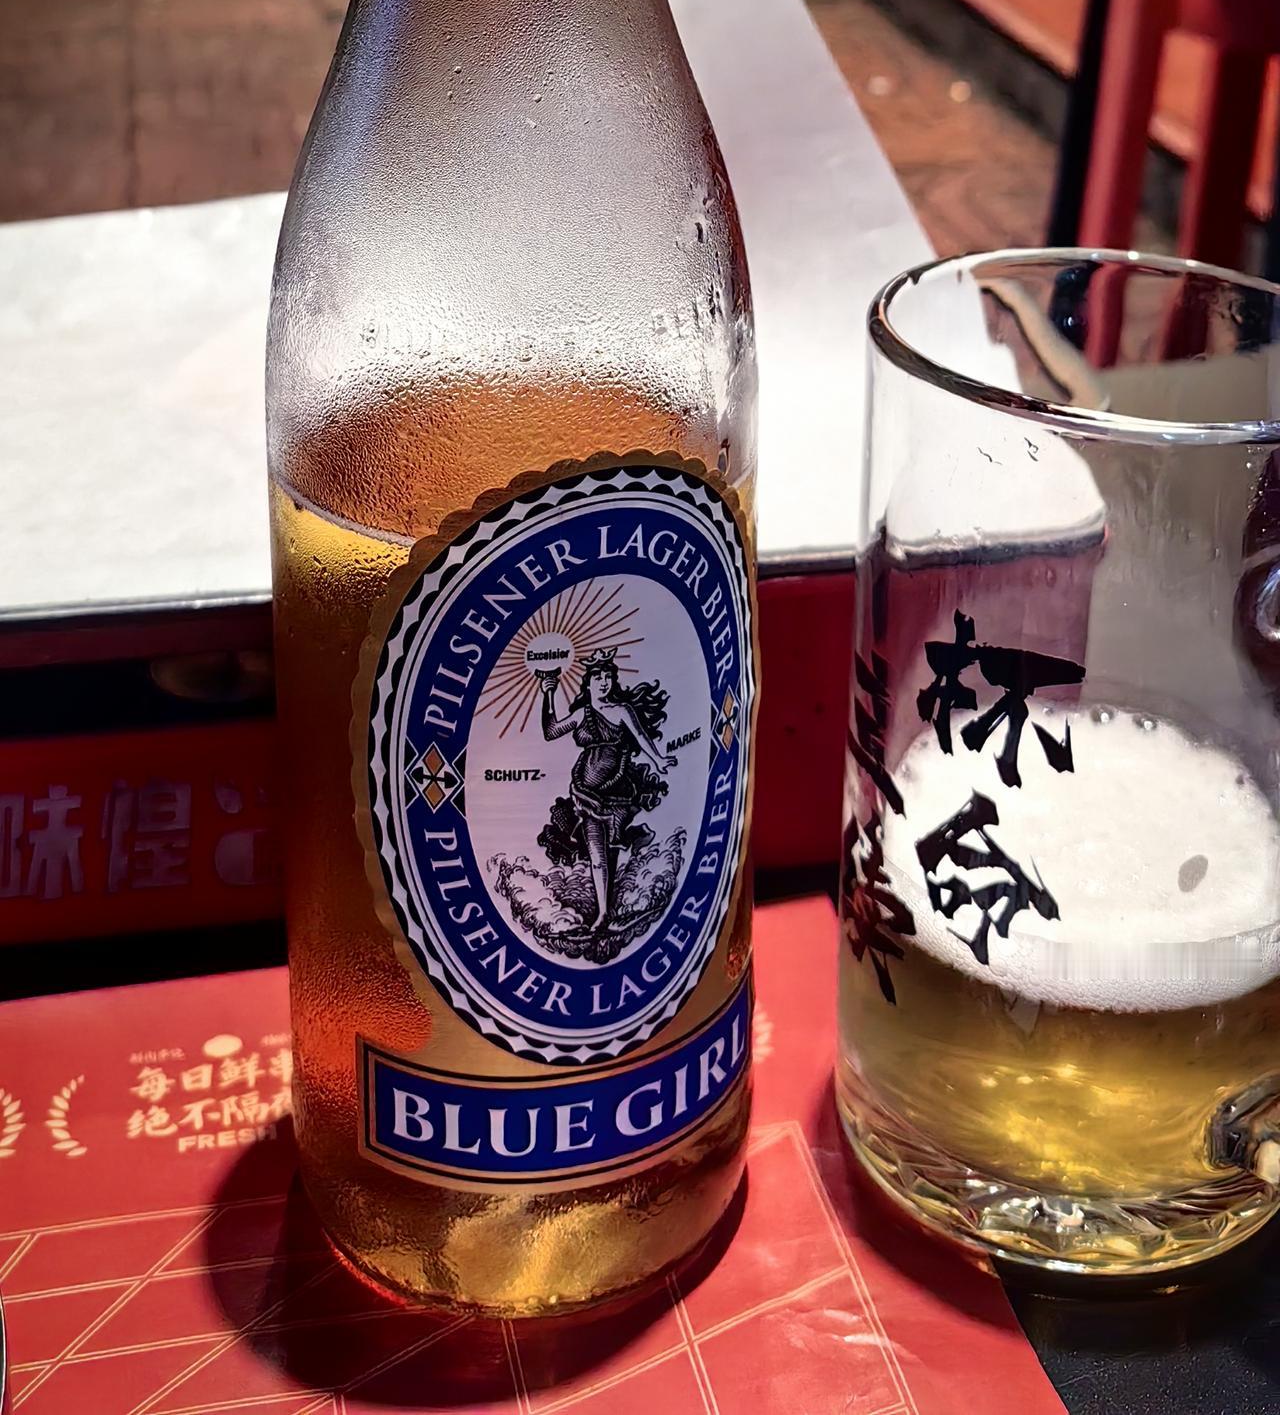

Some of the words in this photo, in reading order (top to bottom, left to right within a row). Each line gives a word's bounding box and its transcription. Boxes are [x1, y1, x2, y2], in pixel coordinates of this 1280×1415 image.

[423, 537, 588, 736] PILSENER
[596, 521, 707, 599] LAGER
[702, 581, 736, 687] BIER
[526, 648, 570, 662] Excelsior
[666, 727, 702, 753] MARKE
[484, 768, 547, 782] SCHUTZ-
[423, 829, 572, 1016] PILSENER
[590, 895, 707, 1016] LAGER
[694, 764, 735, 880] BIER
[391, 1087, 596, 1158] BLUE
[614, 1013, 746, 1138] GIRL
[178, 1124, 277, 1153] FRESH
